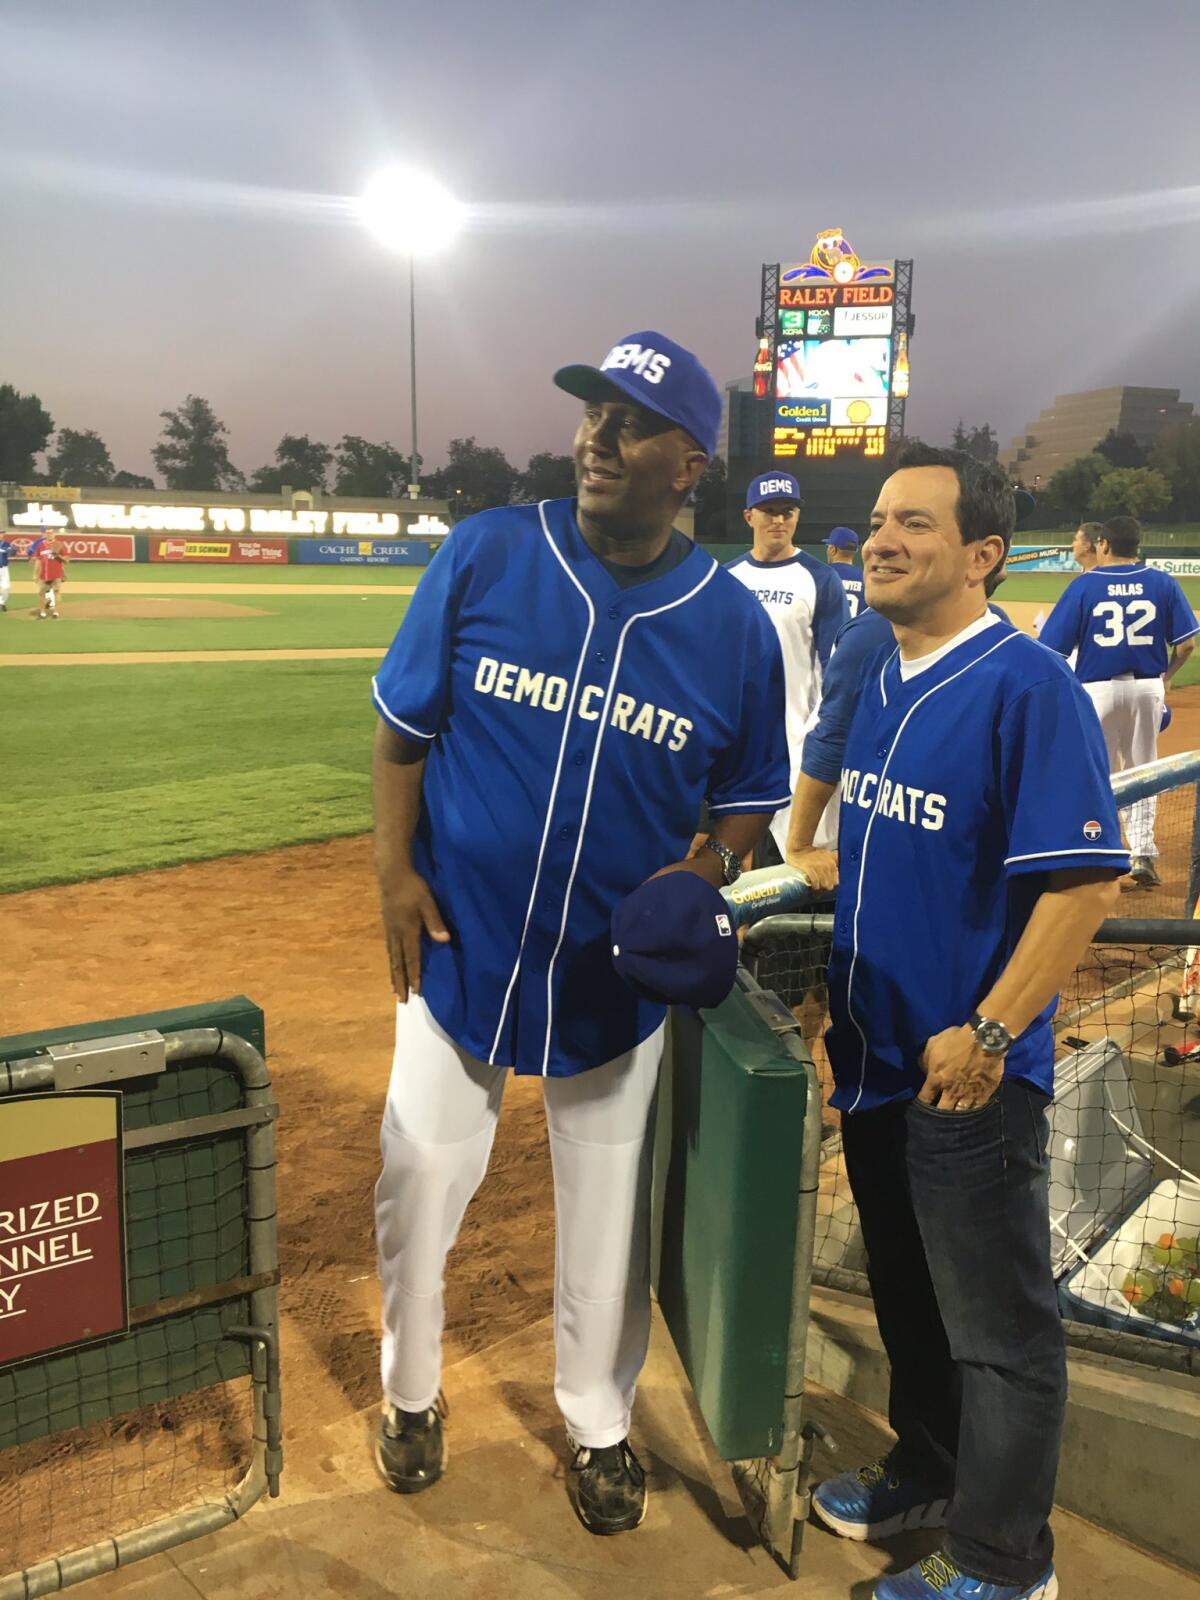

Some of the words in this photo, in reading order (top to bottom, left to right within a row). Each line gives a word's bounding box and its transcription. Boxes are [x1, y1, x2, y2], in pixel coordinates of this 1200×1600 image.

[780, 288, 837, 305] RALEY
[842, 286, 894, 303] FIELD
[784, 311, 802, 327] 3
[759, 478, 792, 496] DEMS
[319, 545, 356, 555] CACHE
[373, 546, 409, 555] CREEK
[1039, 548, 1059, 558] MUSIC
[1107, 583, 1144, 597] SALAS
[1092, 599, 1157, 647] 32
[0, 1192, 100, 1234] RIZED
[0, 1283, 22, 1313] Y
